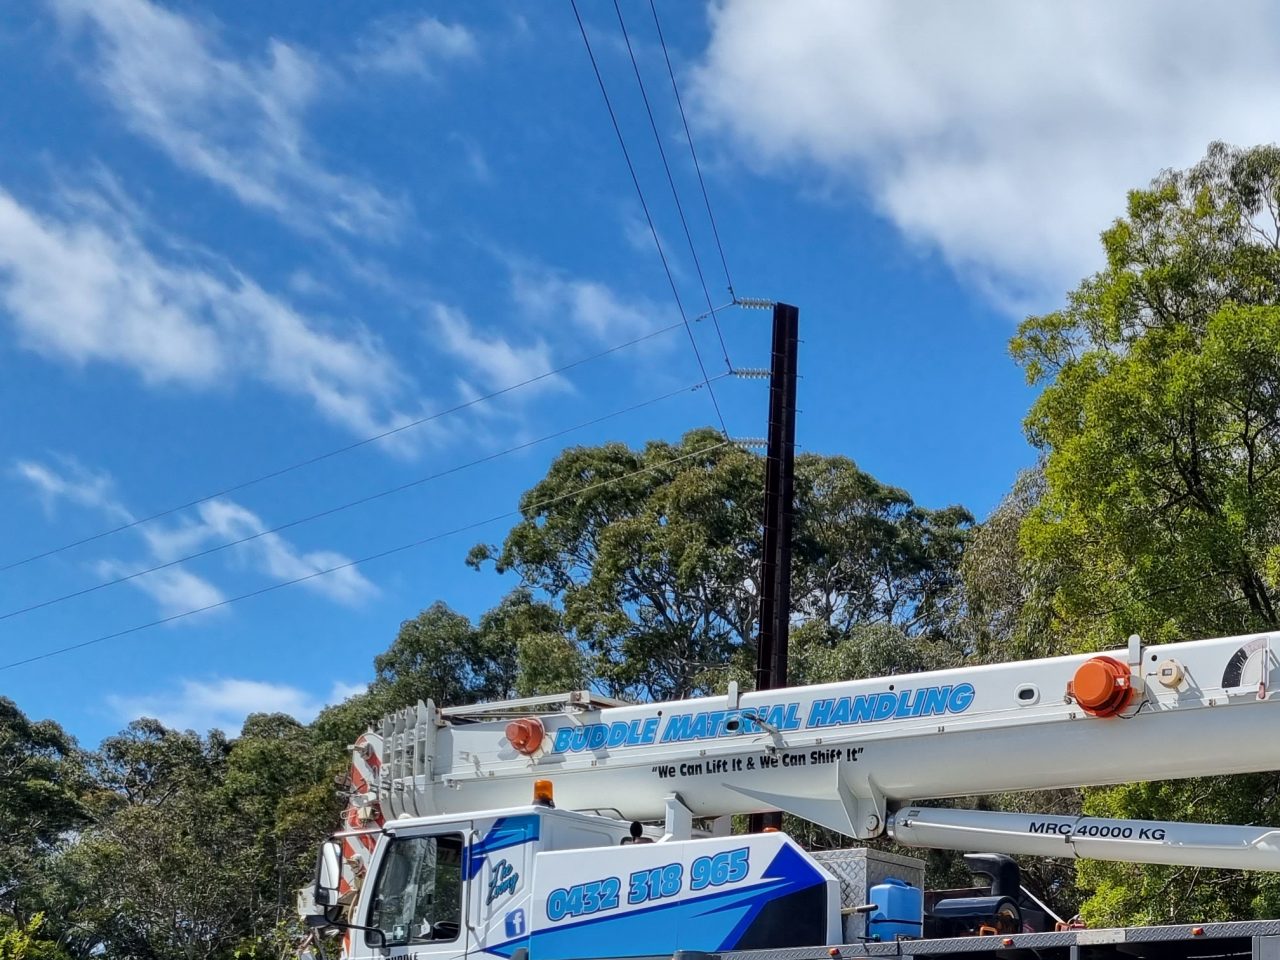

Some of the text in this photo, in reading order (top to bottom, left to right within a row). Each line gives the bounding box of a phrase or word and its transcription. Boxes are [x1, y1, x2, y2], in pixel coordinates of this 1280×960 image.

[551, 682, 976, 754] BUDDLE MATERIAL HANDLING
[680, 763, 702, 776] Can
[706, 760, 728, 774] Lift
[732, 758, 743, 772] It
[746, 757, 755, 770] &
[760, 755, 778, 769] We
[782, 753, 806, 767] Can
[810, 749, 842, 764] Shift
[1029, 822, 1166, 840] MRC 40000 KG
[546, 847, 750, 922] 0432 318 965
